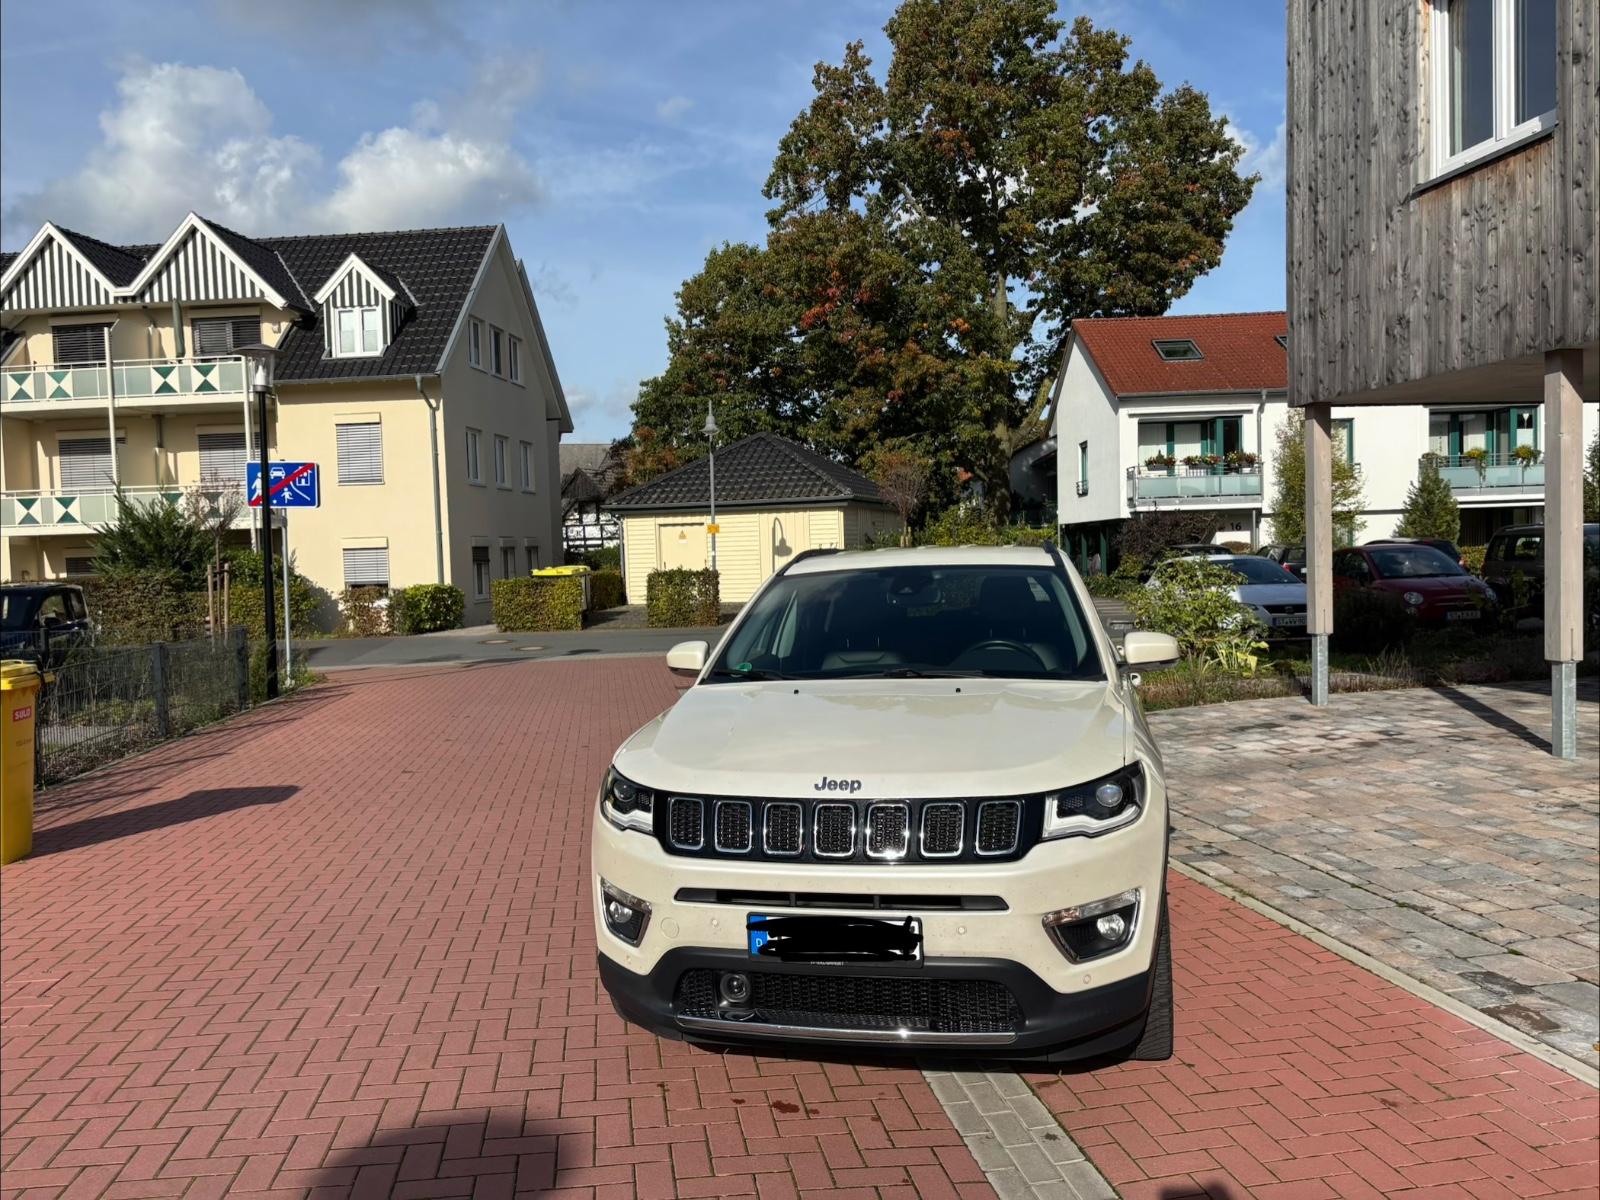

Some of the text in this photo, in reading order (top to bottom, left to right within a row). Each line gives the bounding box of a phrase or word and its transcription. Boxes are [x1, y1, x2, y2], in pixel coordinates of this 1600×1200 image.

[1230, 521, 1242, 531] 16
[814, 776, 862, 794] Jeep
[755, 937, 763, 947] D
